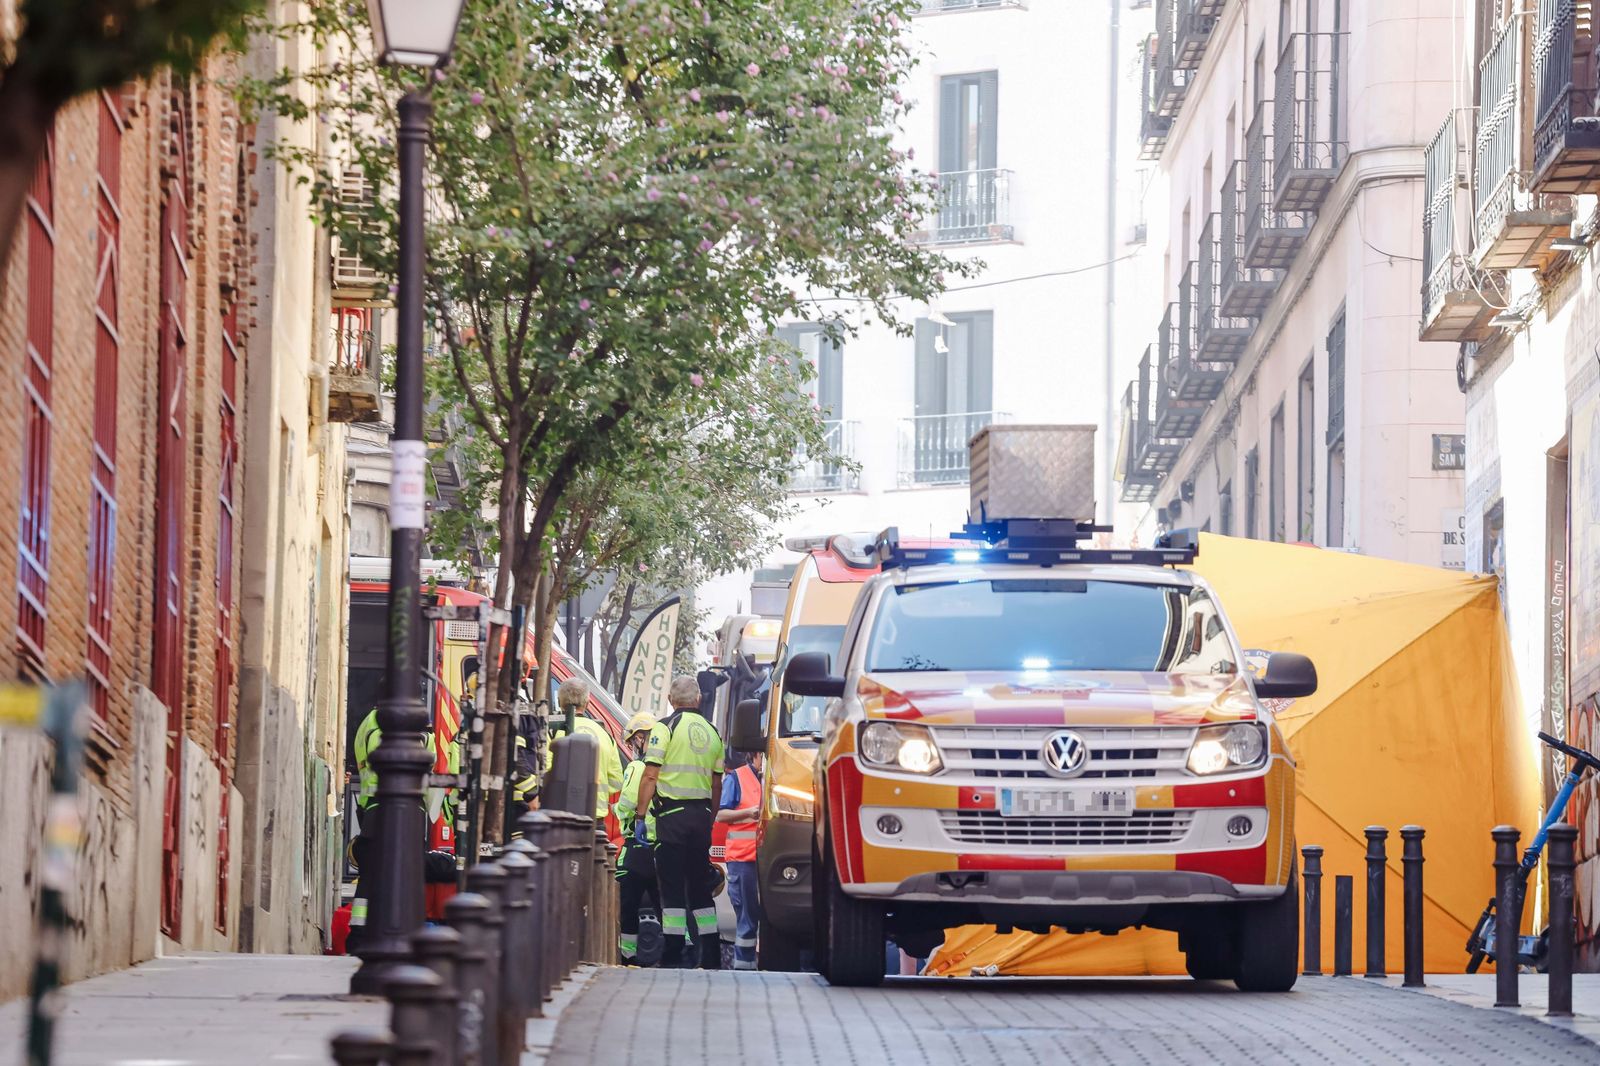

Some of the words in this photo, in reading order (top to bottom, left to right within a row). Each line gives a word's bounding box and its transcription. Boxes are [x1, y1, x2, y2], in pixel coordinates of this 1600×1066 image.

[1439, 453, 1456, 466] SAN
[1443, 531, 1458, 545] DE
[631, 641, 650, 716] NATU
[651, 613, 670, 716] HORCH
